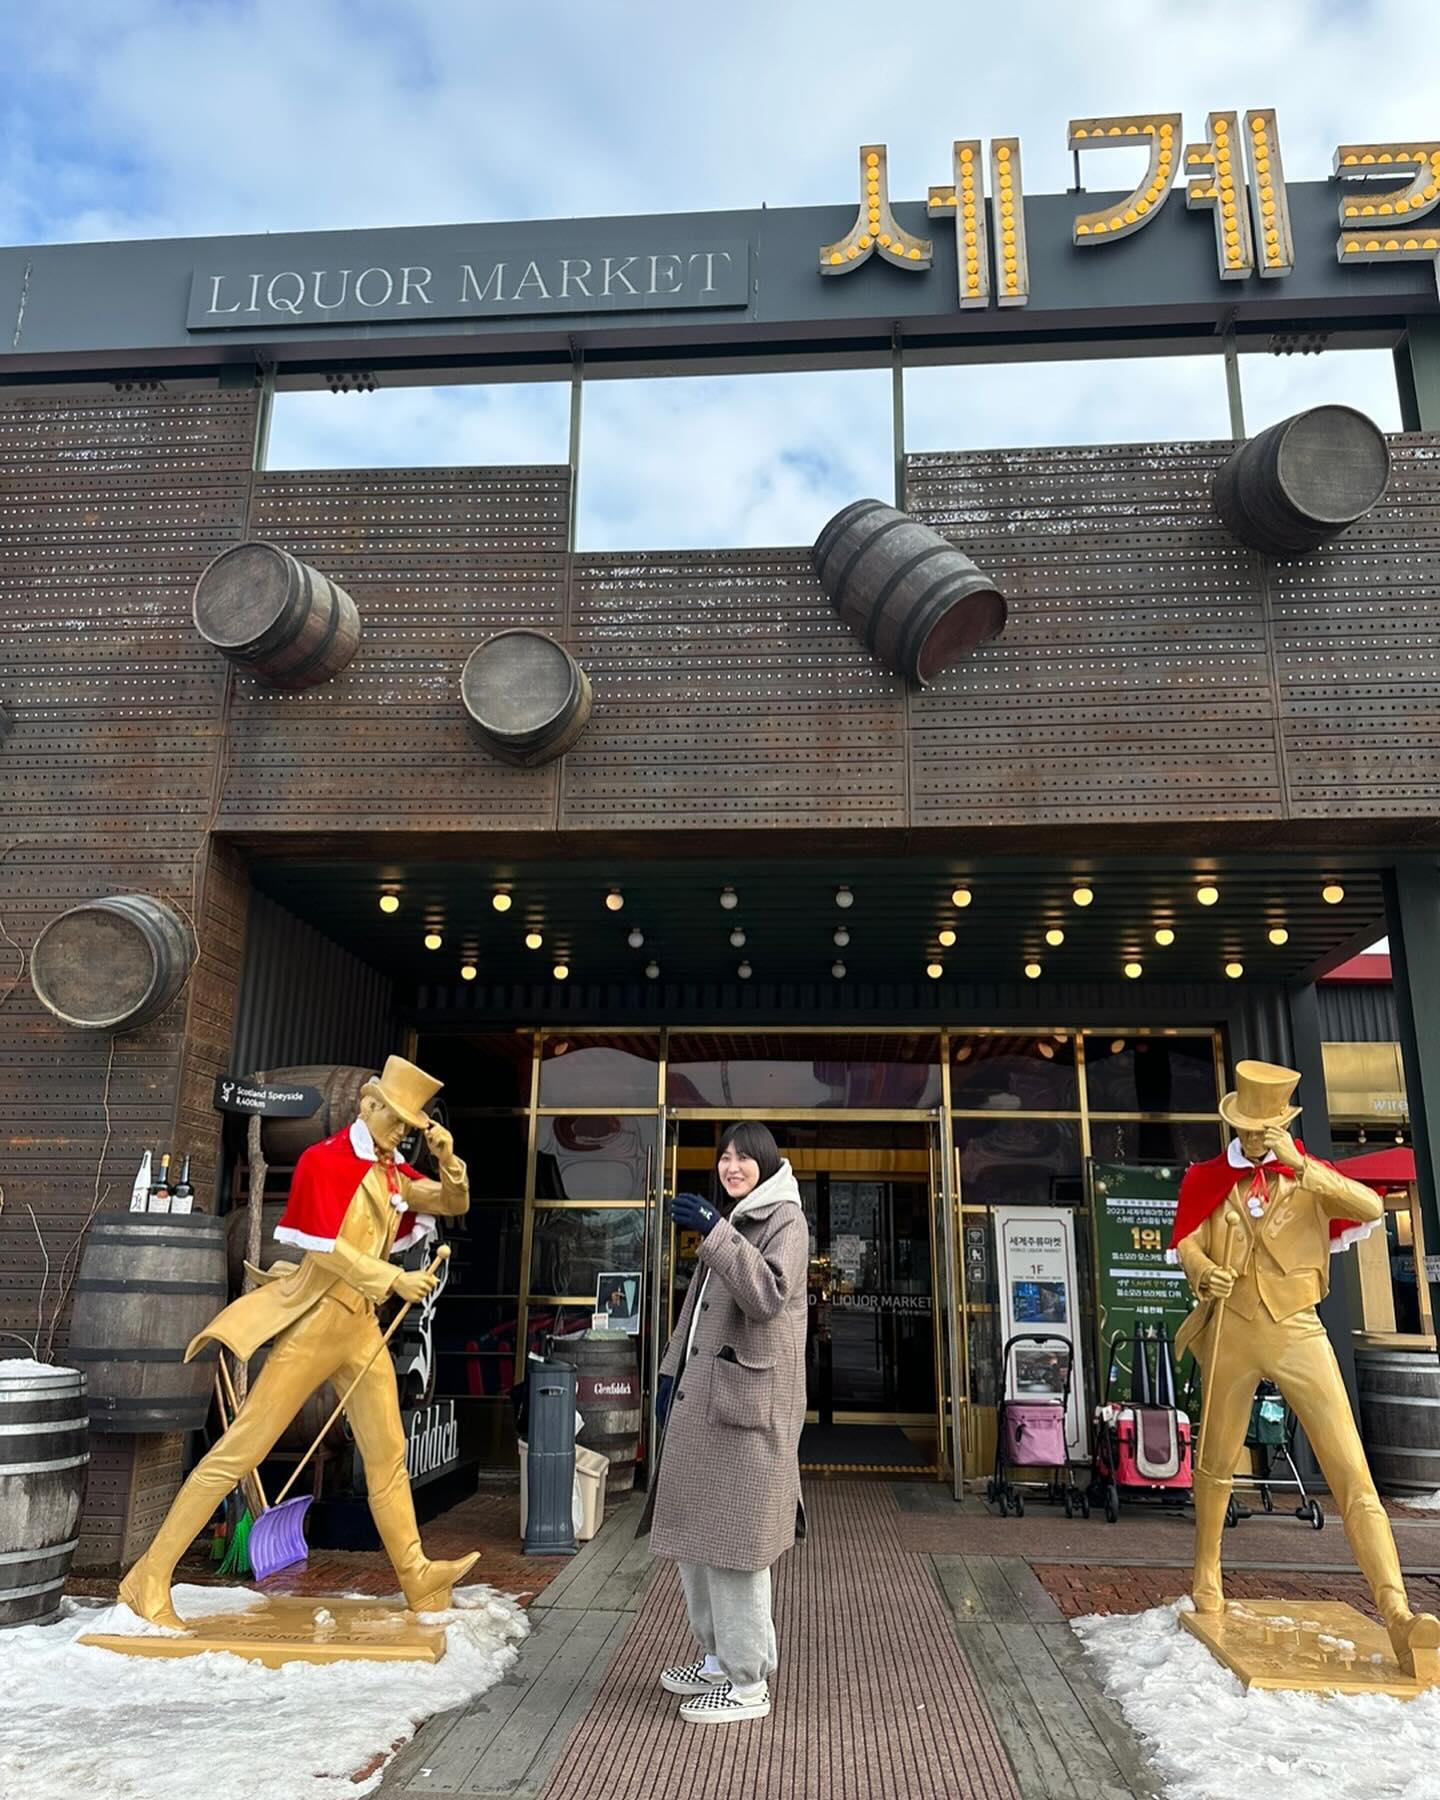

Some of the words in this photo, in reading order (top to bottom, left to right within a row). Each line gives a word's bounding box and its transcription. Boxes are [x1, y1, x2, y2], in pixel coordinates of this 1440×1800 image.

[206, 266, 433, 316] LIQUOR
[460, 252, 732, 303] MARKET
[236, 1086, 266, 1099] Scotland
[267, 1091, 304, 1102] Speyside
[1009, 1236, 1062, 1248] 세계주류마켓
[1130, 1226, 1161, 1250] 1위
[1030, 1264, 1044, 1275] 1F
[832, 1294, 879, 1307] LIQUOR
[880, 1295, 933, 1309] MARKET
[406, 1399, 458, 1480] fiddich
